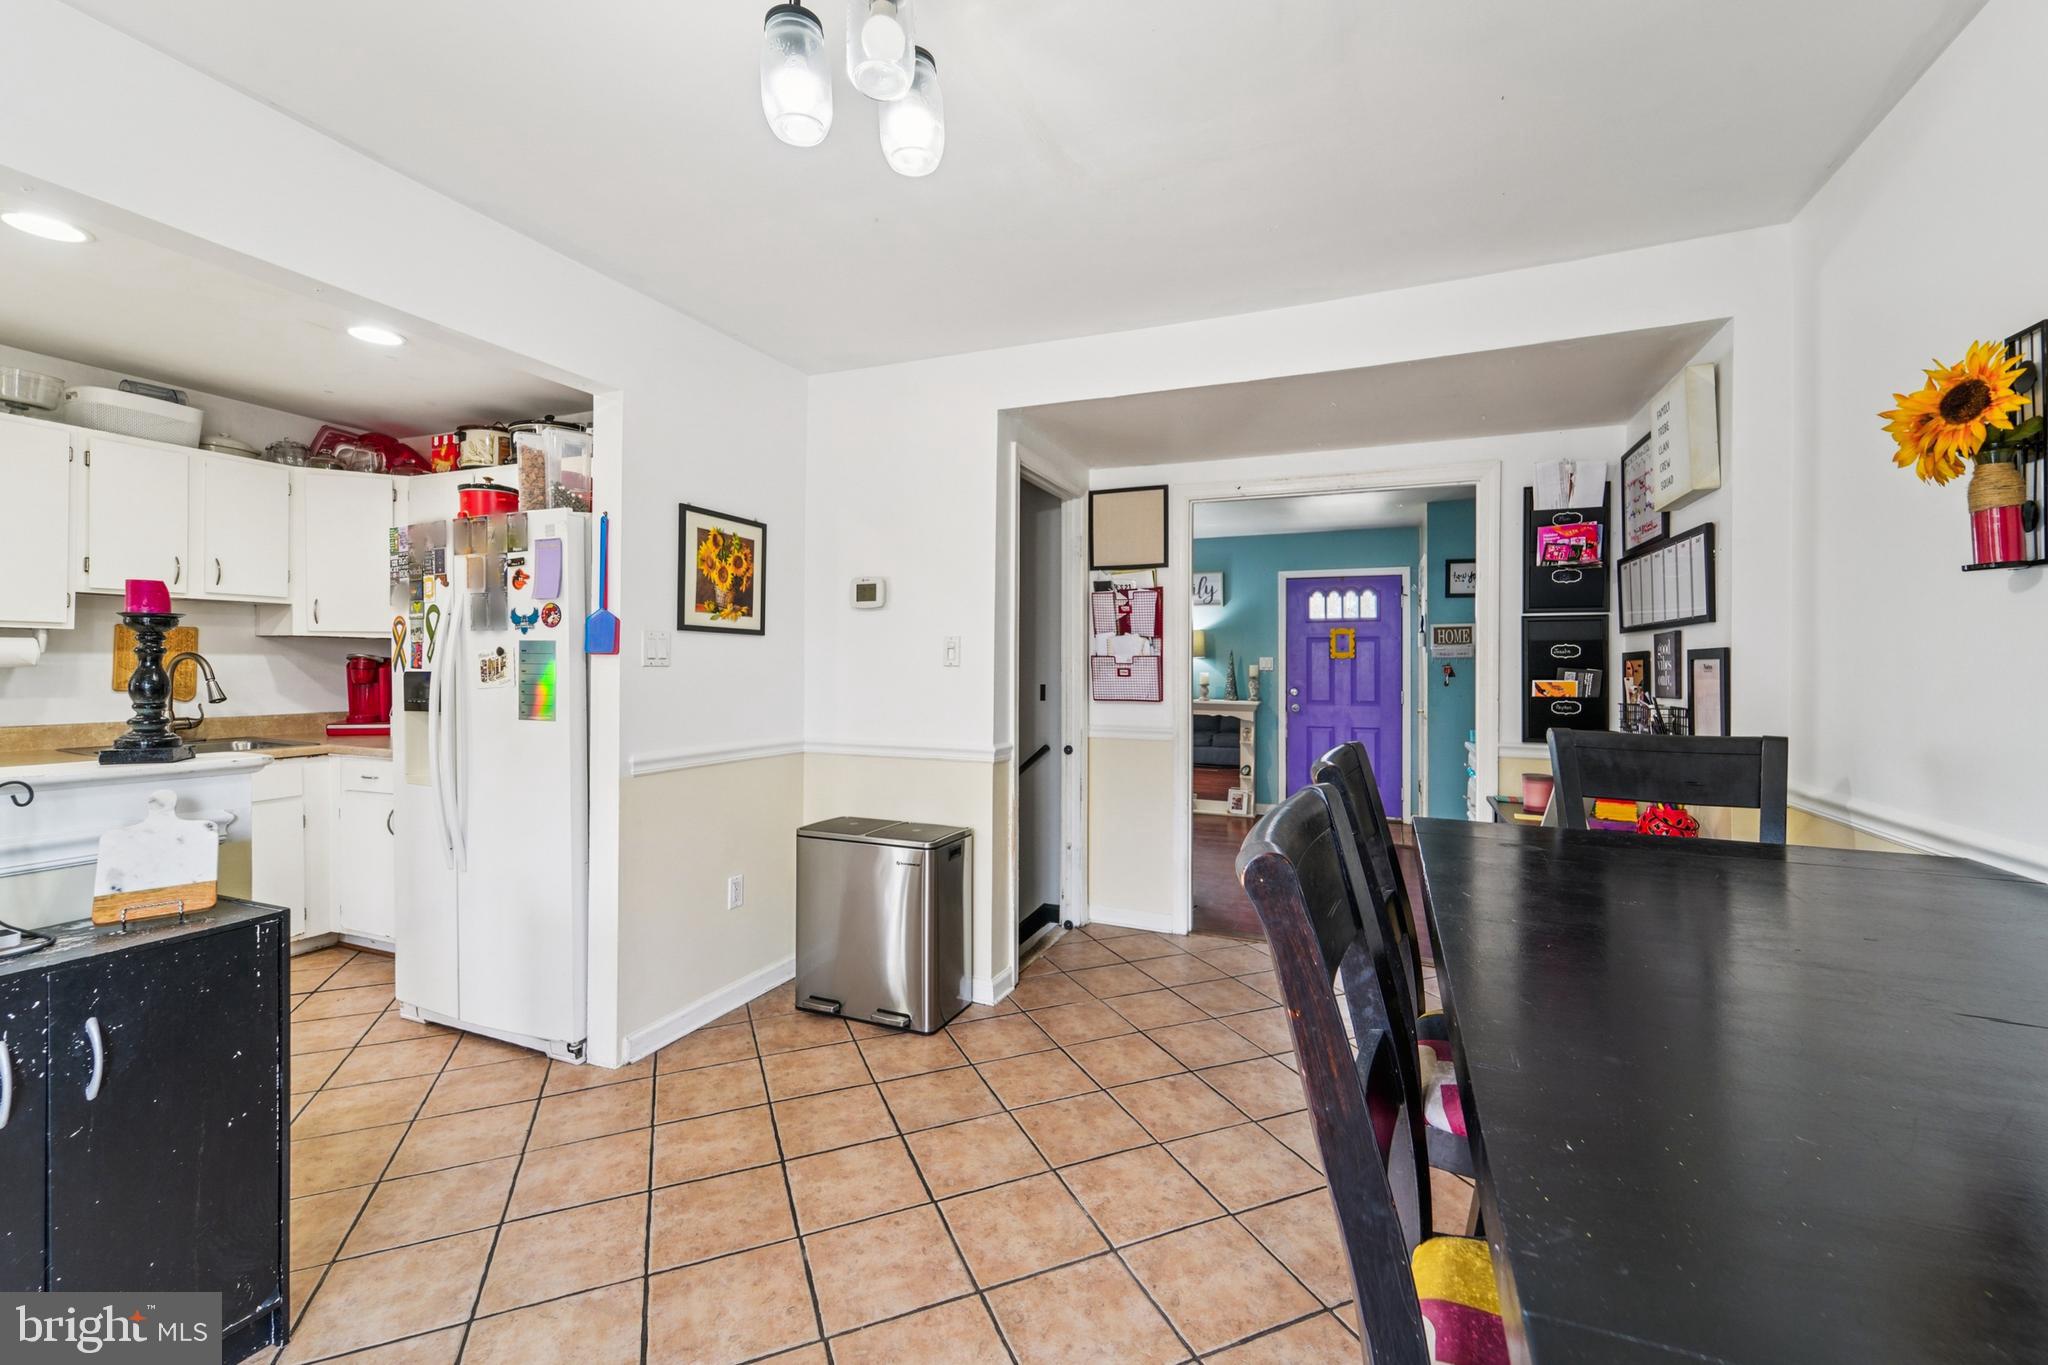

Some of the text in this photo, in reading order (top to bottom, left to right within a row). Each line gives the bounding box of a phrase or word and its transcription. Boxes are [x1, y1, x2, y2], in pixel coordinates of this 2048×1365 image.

[1658, 440, 1670, 455] CLAN
[1659, 458, 1671, 473] CREW
[1660, 475, 1674, 491] SQUAD
[1193, 576, 1217, 604] ily
[1437, 628, 1470, 644] HOME
[1657, 639, 1671, 659] good
[1657, 655, 1672, 671] vibes
